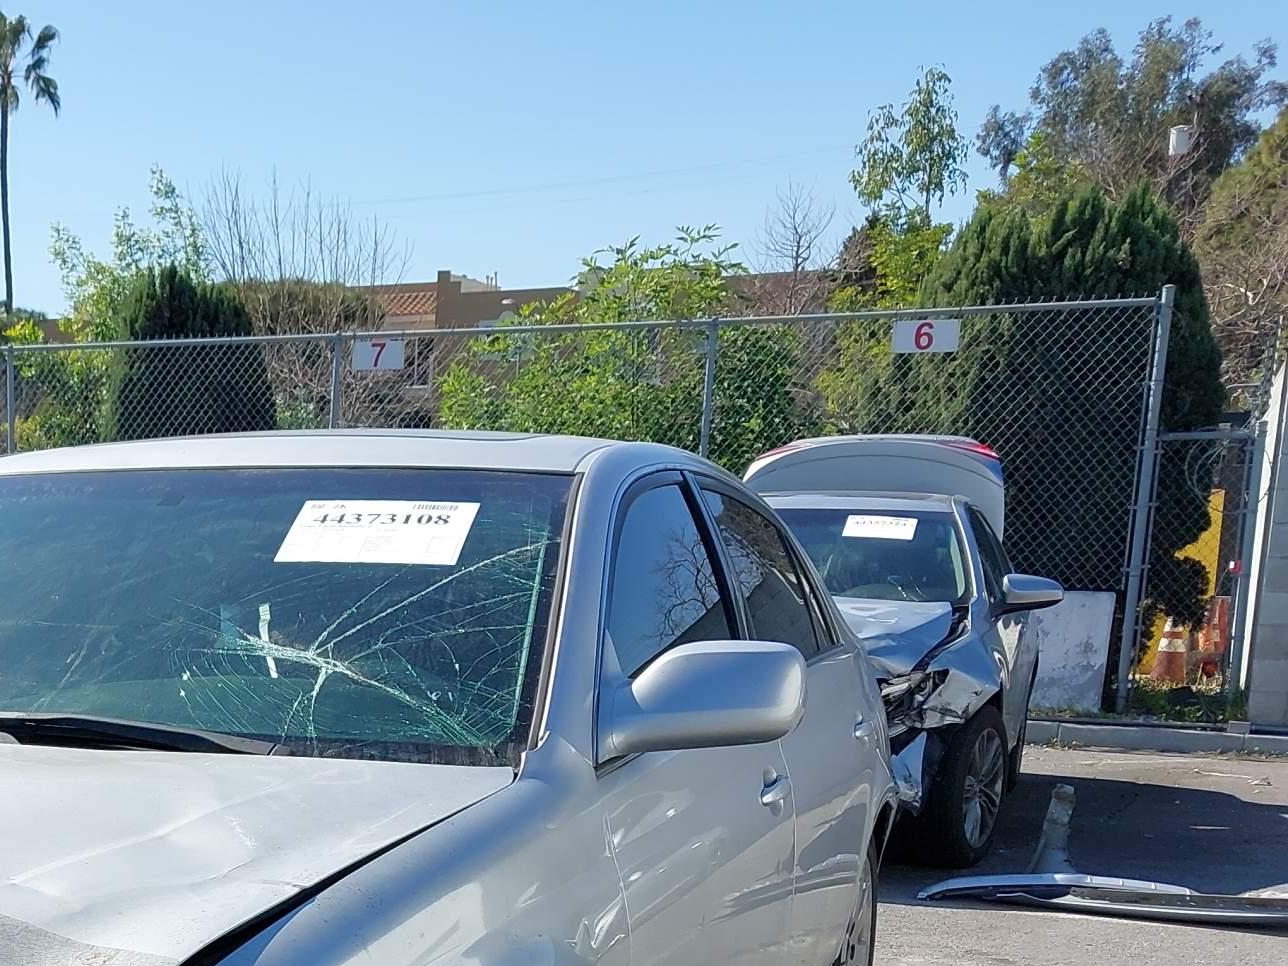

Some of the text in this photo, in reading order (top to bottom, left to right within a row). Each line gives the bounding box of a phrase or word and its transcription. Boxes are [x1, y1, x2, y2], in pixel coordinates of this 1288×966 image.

[914, 321, 935, 351] 6
[371, 342, 387, 368] 7
[312, 513, 451, 525] 44373108
